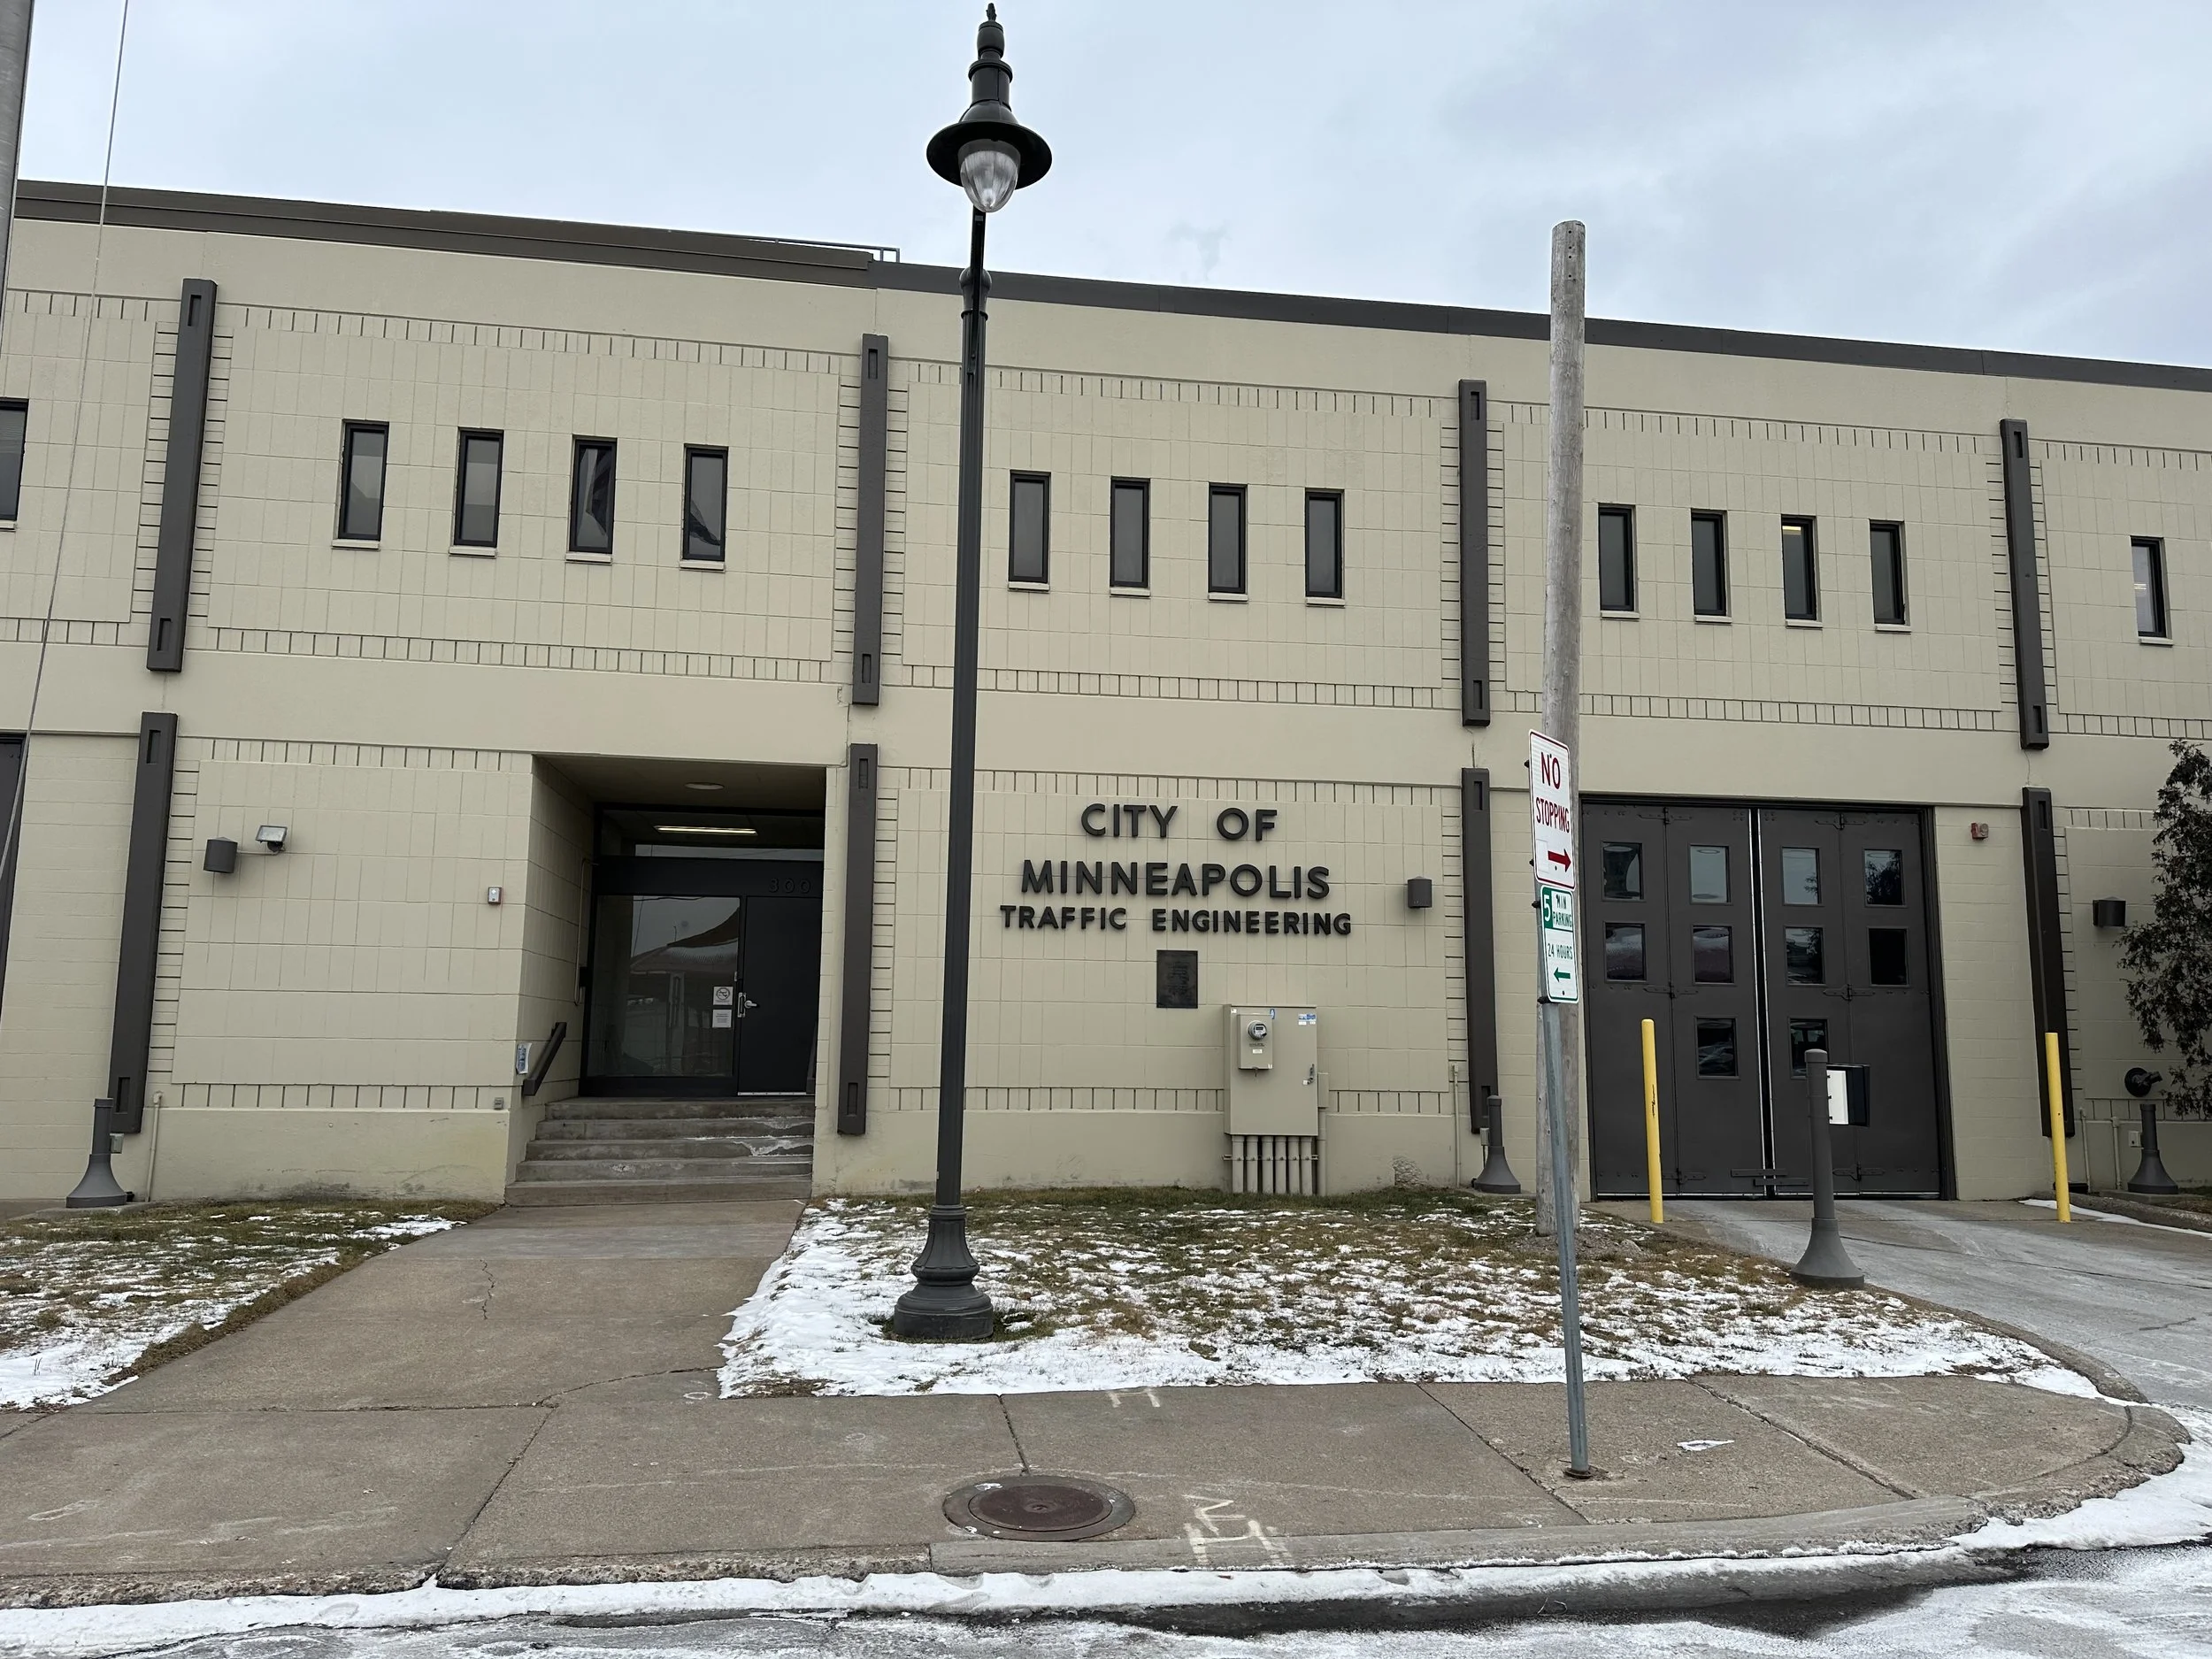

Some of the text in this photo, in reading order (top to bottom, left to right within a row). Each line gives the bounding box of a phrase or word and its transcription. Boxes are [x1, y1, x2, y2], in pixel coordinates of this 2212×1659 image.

[1541, 752, 1561, 789] NO
[1080, 803, 1279, 841] CITY OF
[1536, 797, 1570, 833] STOPPING
[1020, 859, 1330, 901] MINNEAPOLIS
[1543, 894, 1551, 922] 5
[1556, 895, 1567, 910] MIN
[999, 904, 1352, 937] TRAFFIC ENGINEERING
[1553, 911, 1572, 928] PARKING
[1548, 943, 1573, 960] 24 HOURS
